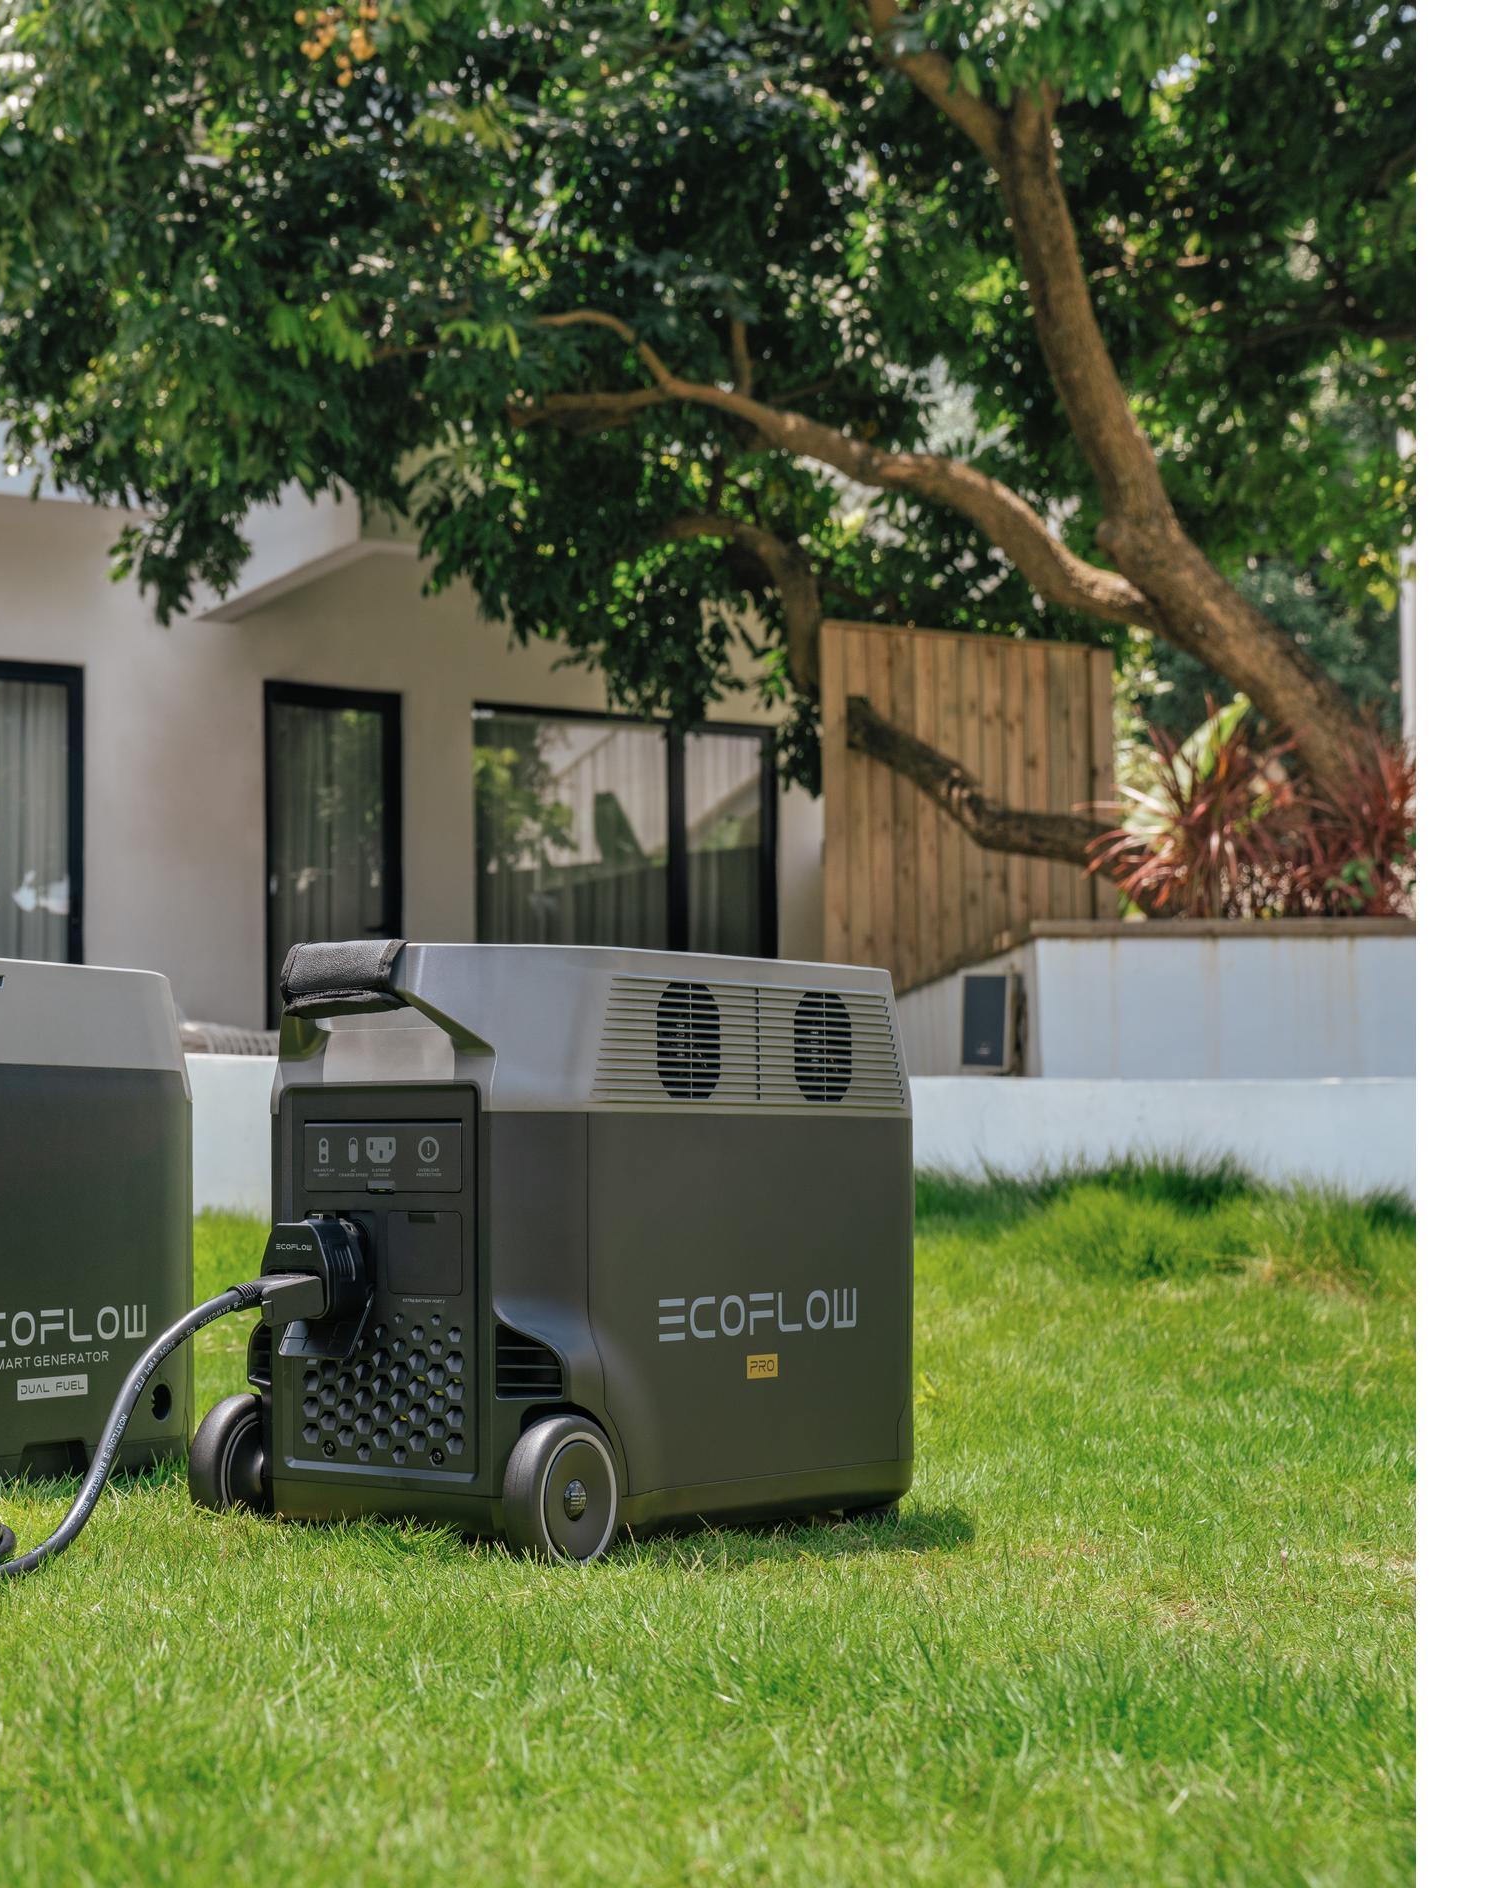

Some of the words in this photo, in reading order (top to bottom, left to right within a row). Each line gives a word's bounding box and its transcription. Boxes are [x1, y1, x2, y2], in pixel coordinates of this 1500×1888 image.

[659, 1288, 856, 1342] ECOFLOW
[34, 1351, 110, 1367] GENERATOR
[750, 1360, 774, 1373] PRO
[20, 1382, 50, 1395] DUAL
[55, 1380, 84, 1392] FUEL
